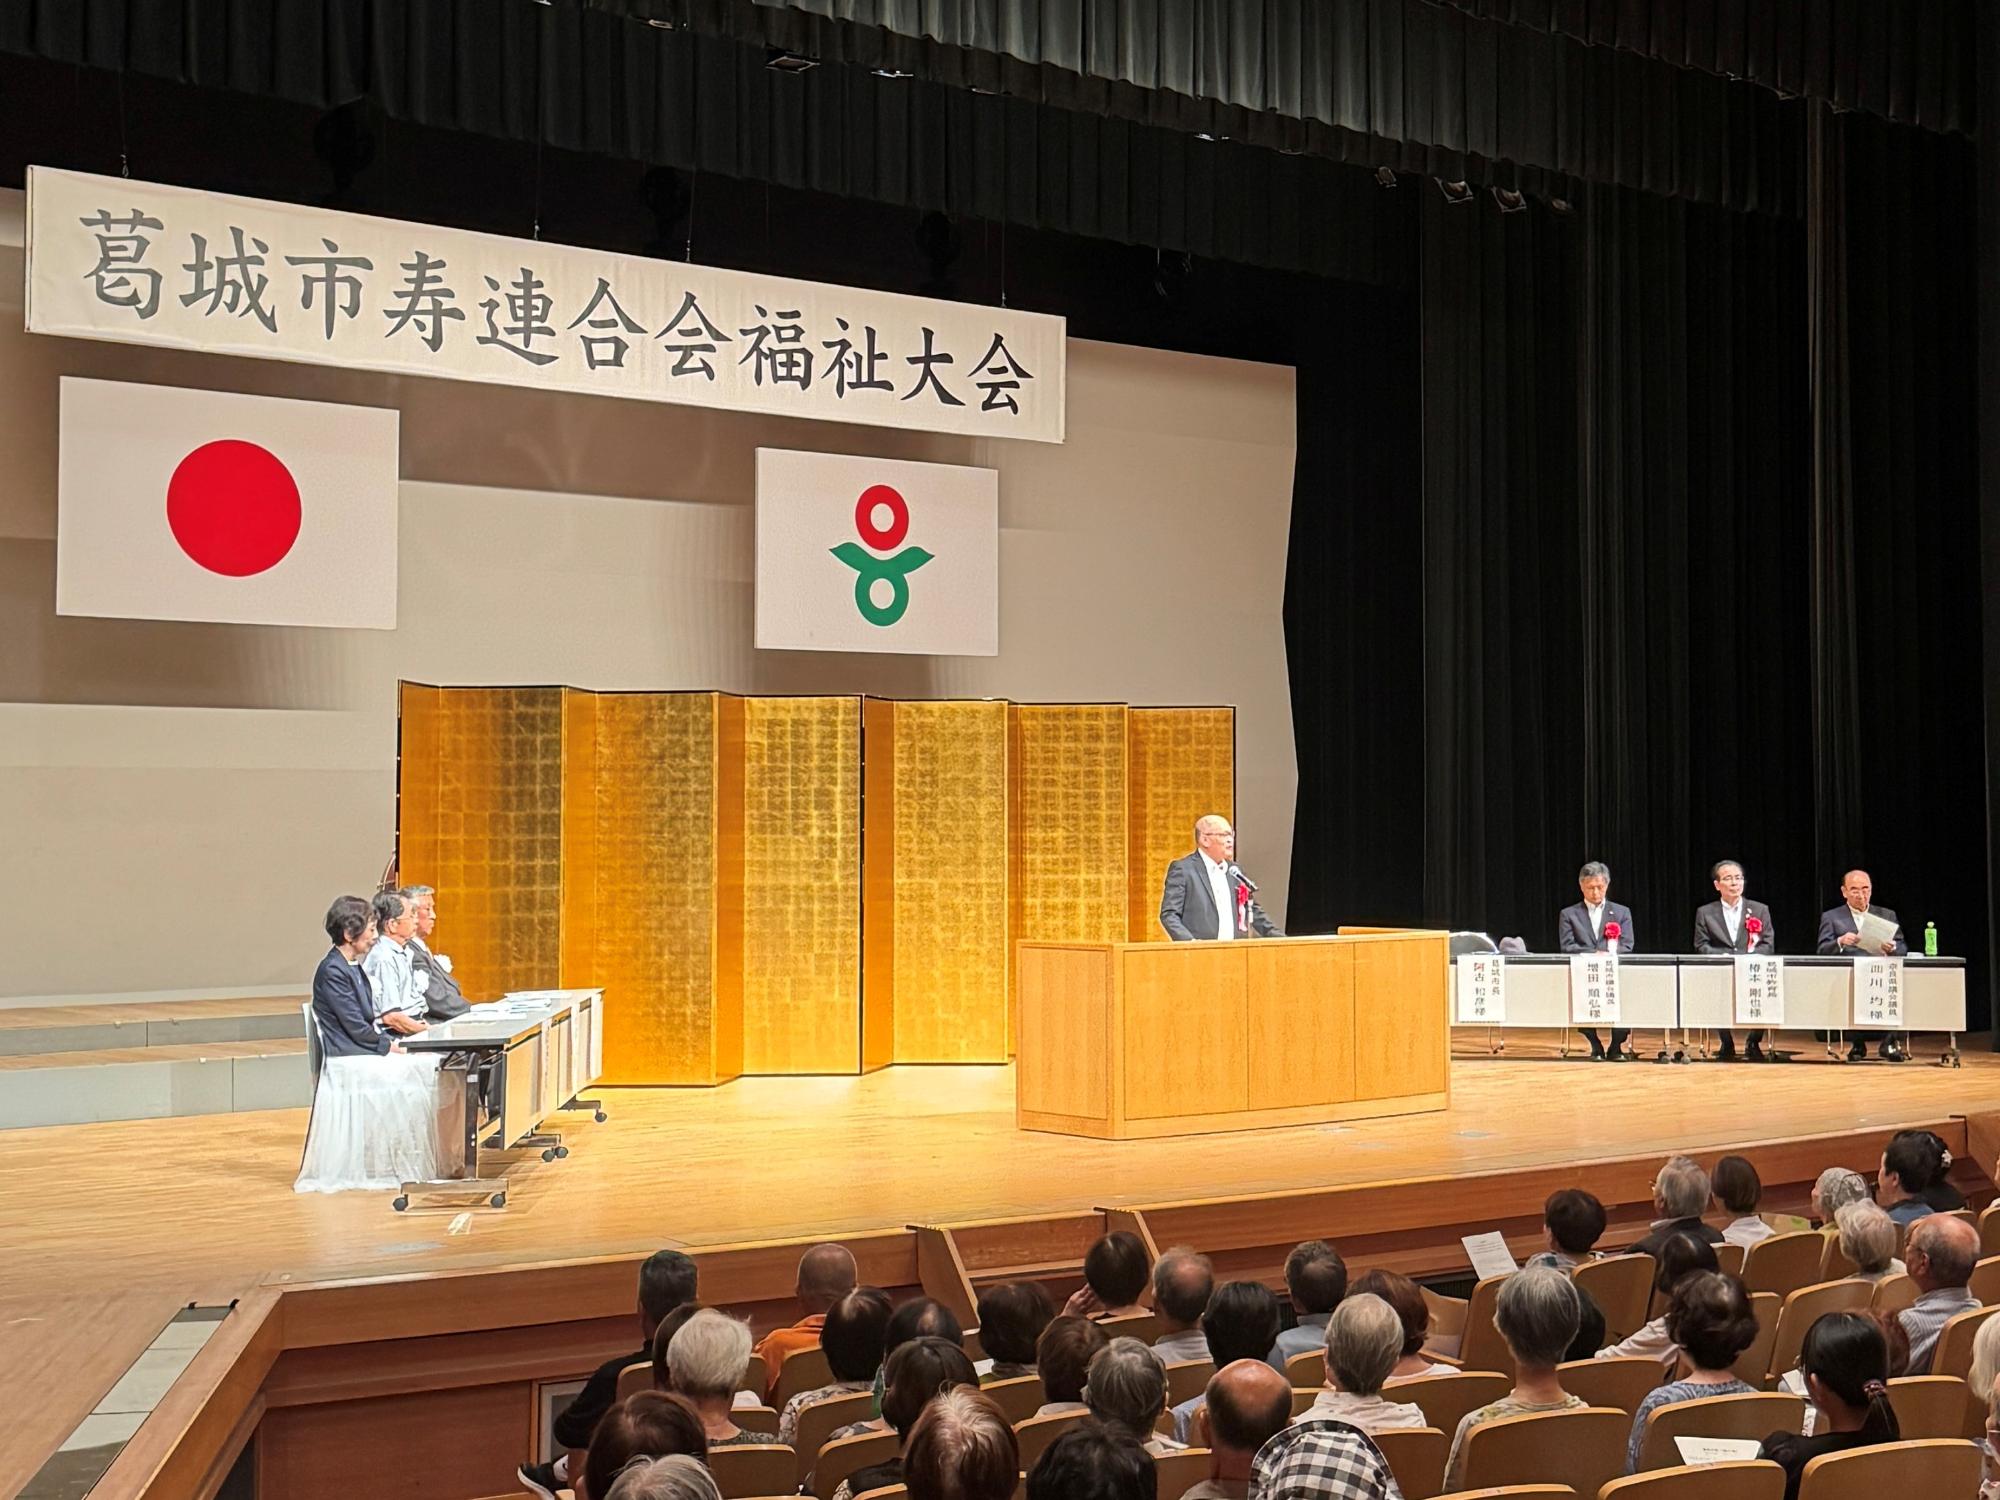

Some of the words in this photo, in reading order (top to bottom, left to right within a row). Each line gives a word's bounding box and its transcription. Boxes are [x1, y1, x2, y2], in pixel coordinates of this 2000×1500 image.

[79, 208, 1034, 416] 葛城市寿連合会福祉大会
